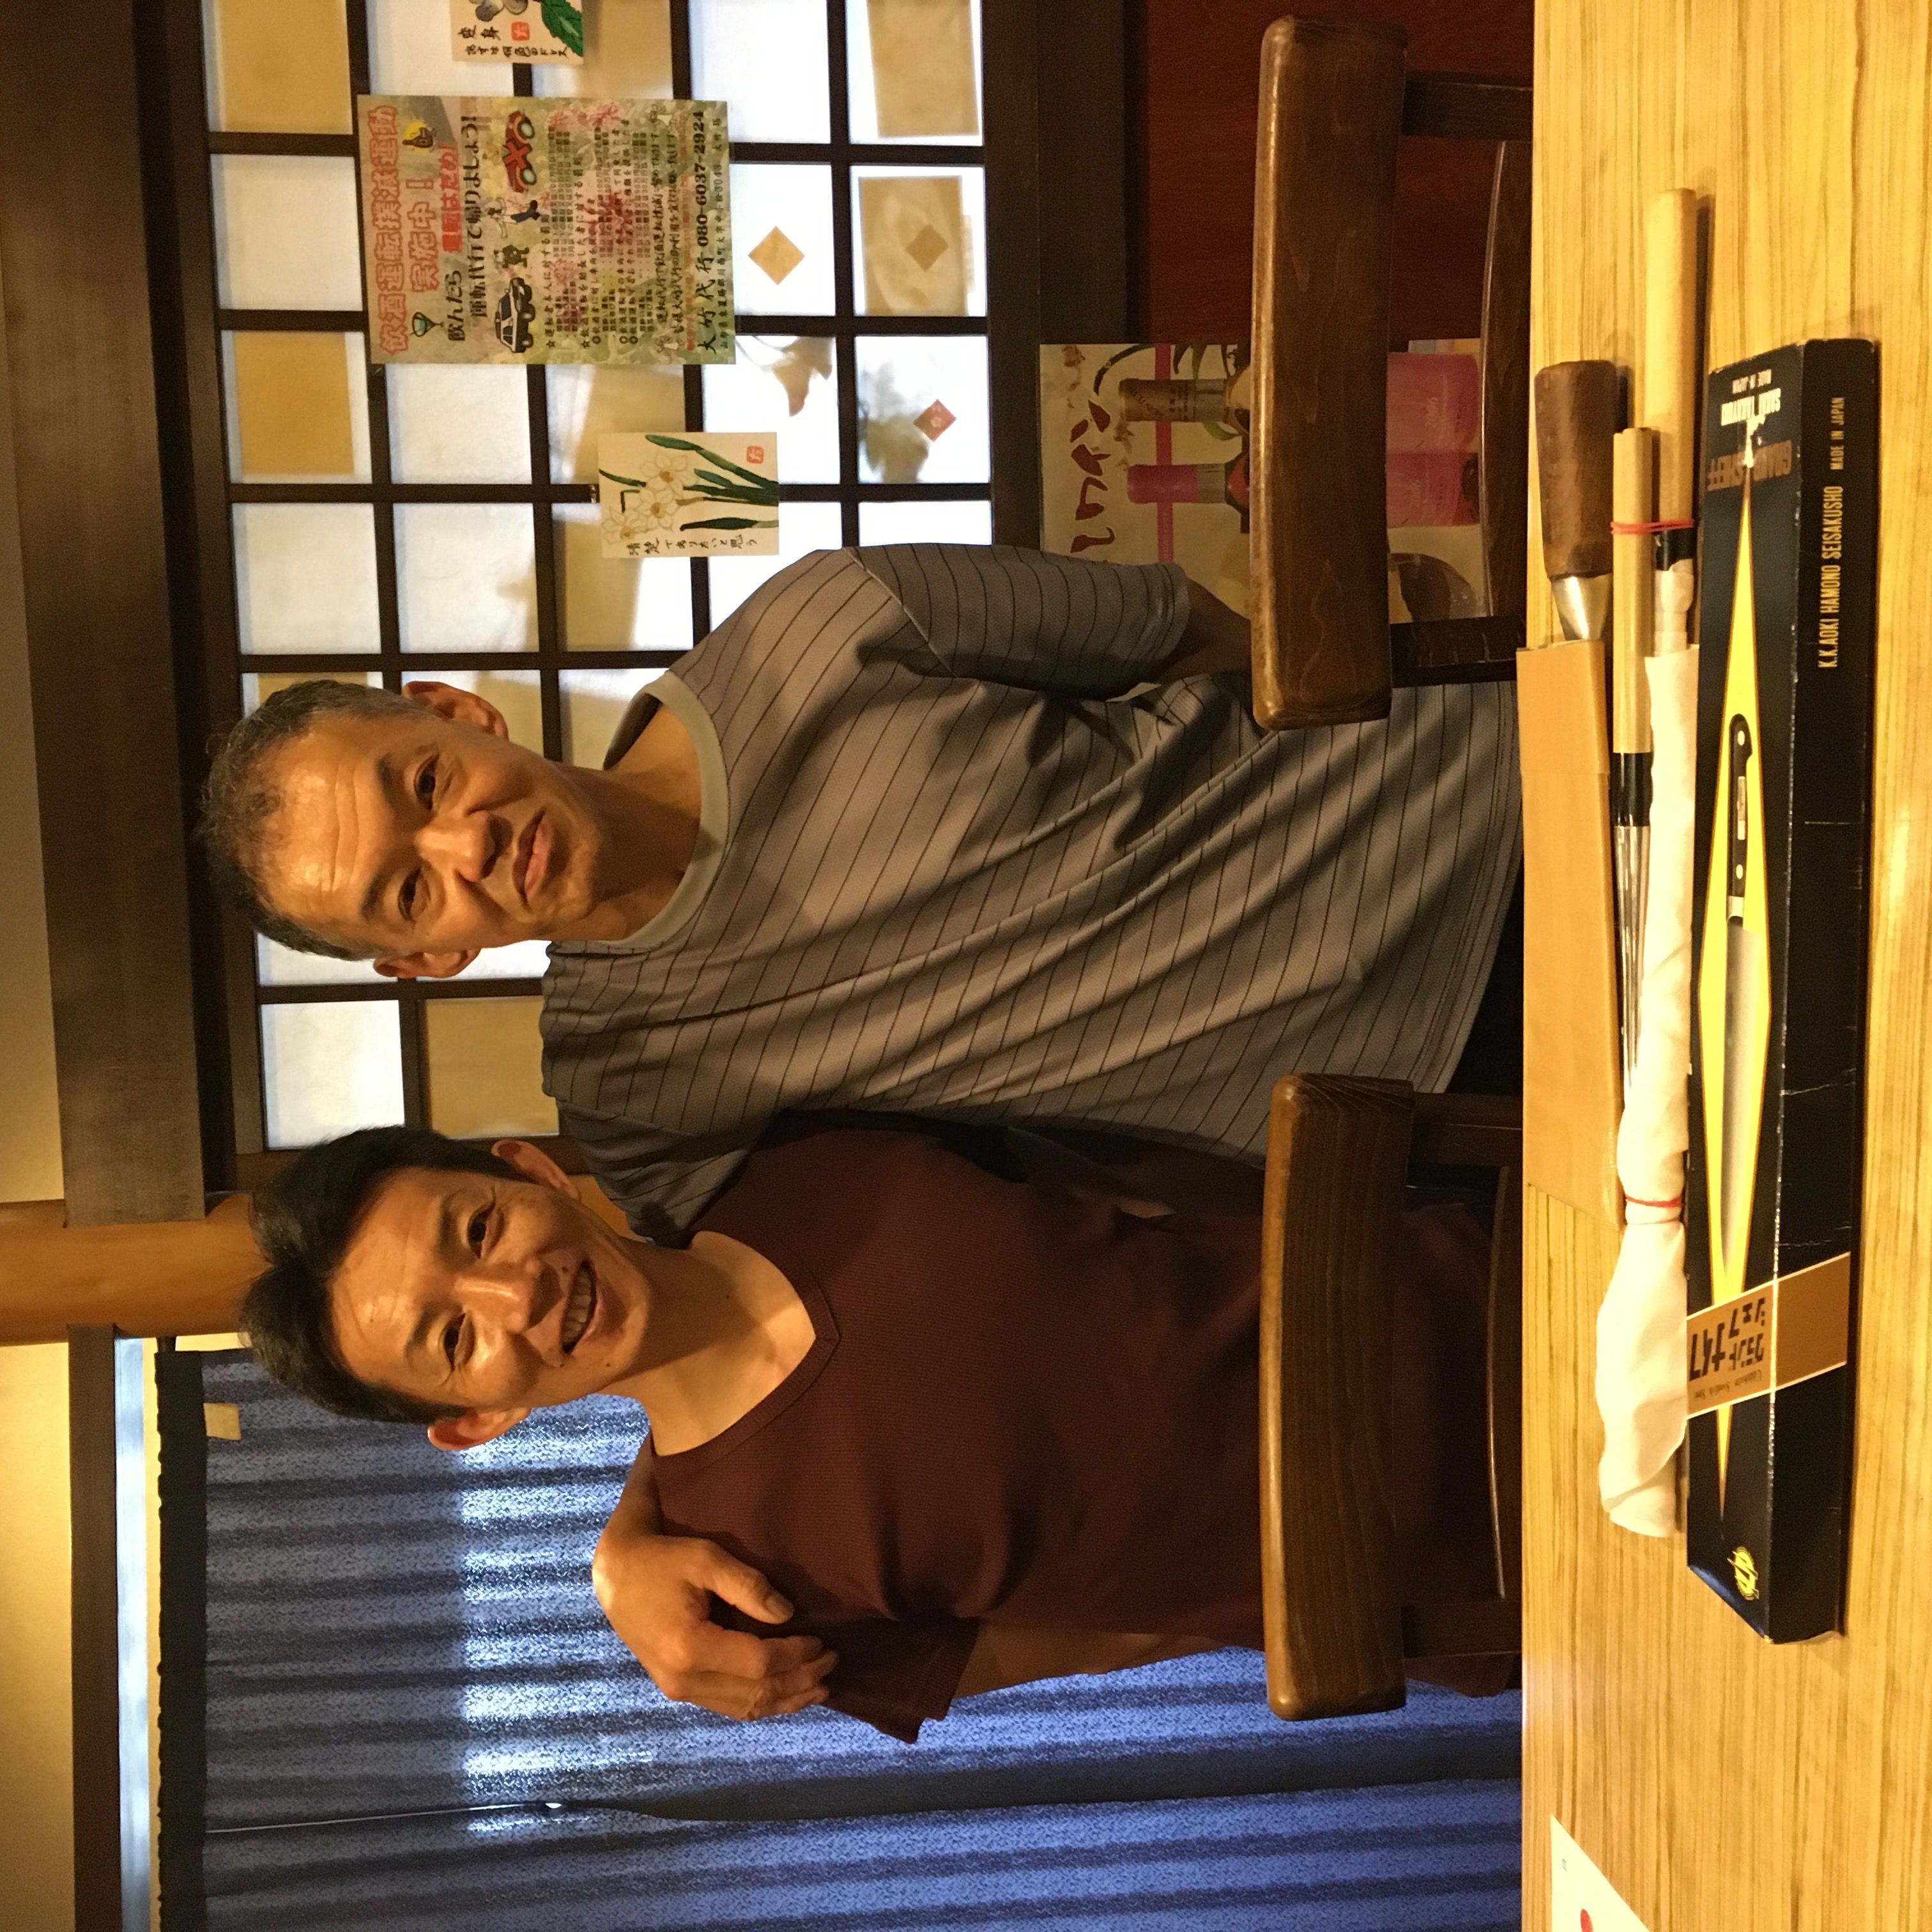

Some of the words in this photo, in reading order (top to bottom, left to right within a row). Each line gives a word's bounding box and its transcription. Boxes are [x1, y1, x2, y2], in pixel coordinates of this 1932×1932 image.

[693, 111, 709, 247] 080-6037-2924
[367, 105, 409, 355] 飲酒運転撲滅運動
[695, 251, 717, 355] 大竹代行
[1830, 397, 1845, 425] JAPAN
[1830, 430, 1844, 440] IN
[1829, 445, 1844, 471] MADE
[1822, 485, 1844, 560] SEISAKUSHO
[1820, 564, 1841, 613] HAMONO
[1818, 618, 1839, 668] K.K.AOKI
[1689, 1322, 1726, 1381] ナイフ
